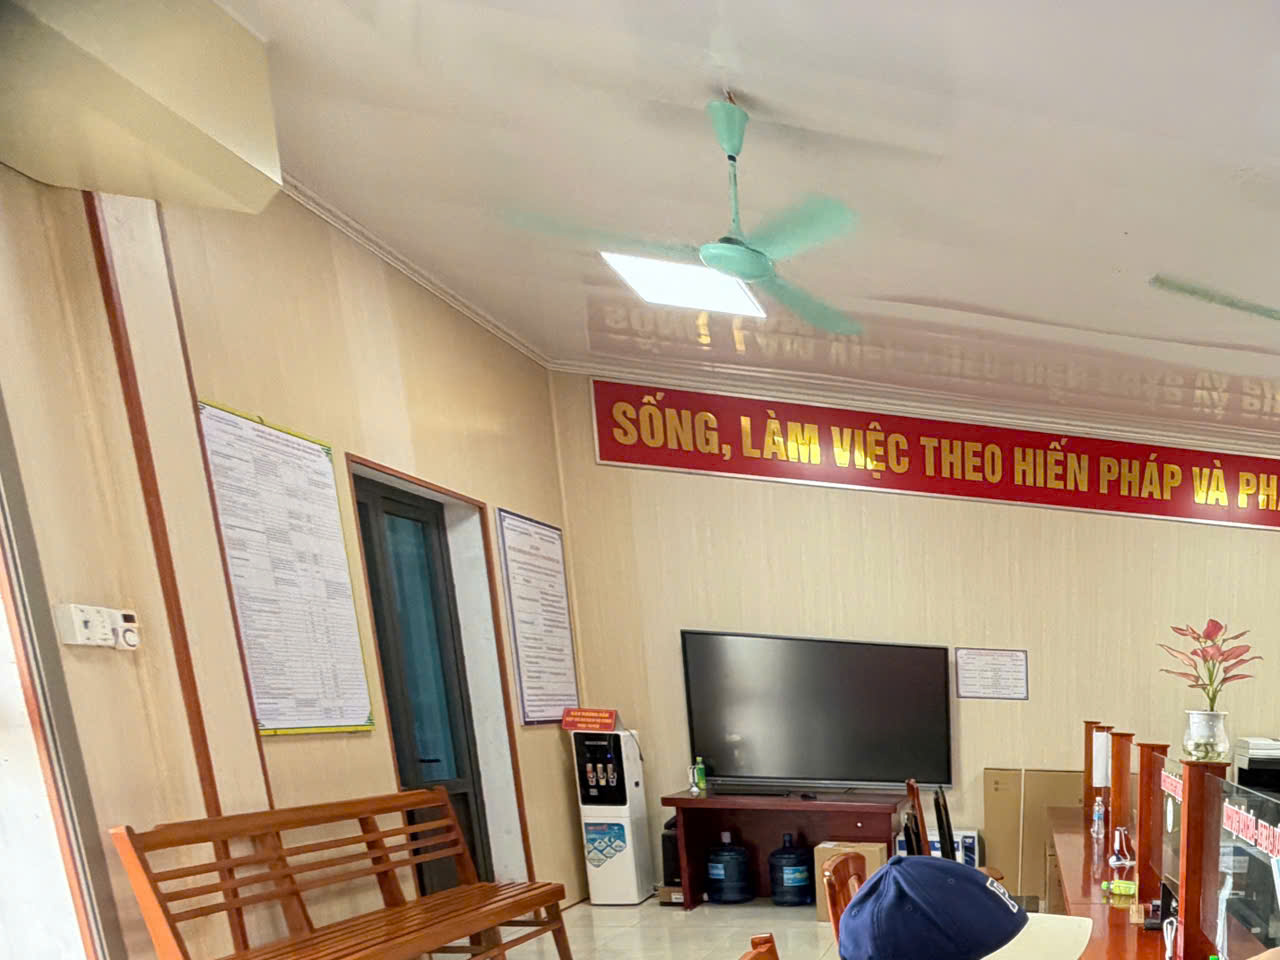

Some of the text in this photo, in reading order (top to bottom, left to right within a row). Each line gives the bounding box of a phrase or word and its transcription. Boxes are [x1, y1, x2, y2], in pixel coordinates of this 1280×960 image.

[612, 393, 732, 460] SỐNG,
[740, 411, 821, 465] LÀM
[831, 425, 909, 480] VIỆC
[922, 440, 1001, 484] THEO
[1014, 438, 1089, 494] HIẾN
[1099, 451, 1182, 502] PHÁP
[1193, 465, 1228, 507] VÀ
